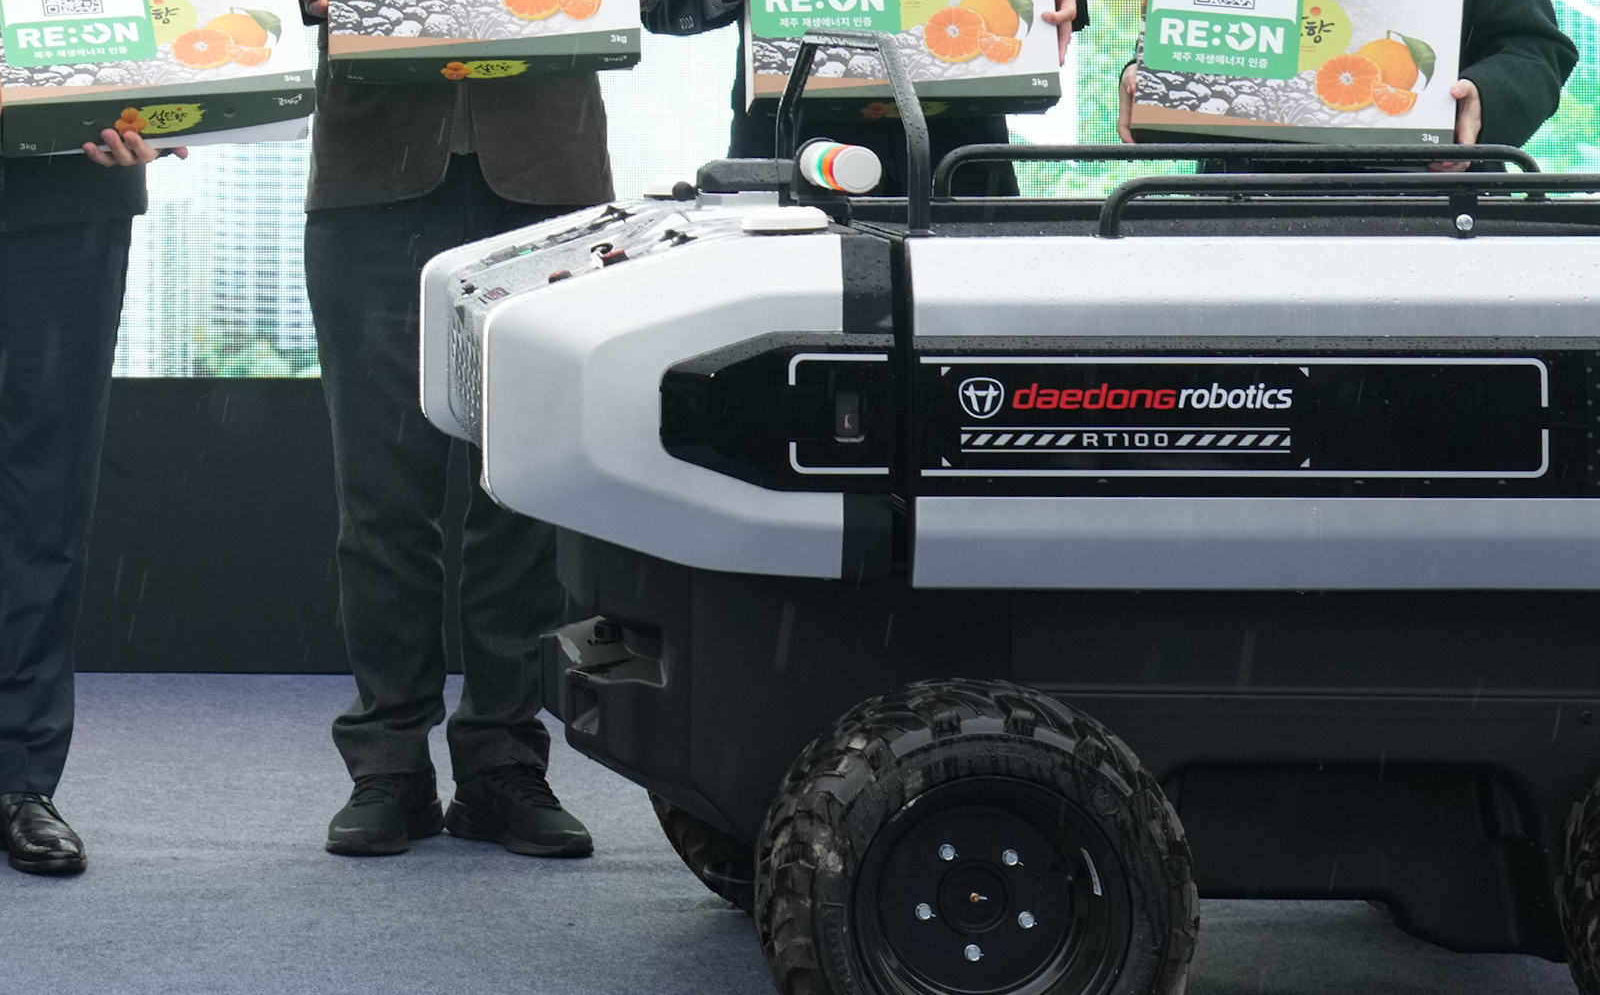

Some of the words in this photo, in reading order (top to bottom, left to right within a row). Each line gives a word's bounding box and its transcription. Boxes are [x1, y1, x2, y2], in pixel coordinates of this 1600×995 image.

[779, 17, 800, 28] 제주
[802, 16, 850, 29] 재생에너지
[852, 16, 873, 28] 인증
[17, 21, 140, 48] RE:ON
[609, 34, 628, 45] 3kg
[1160, 16, 1285, 54] RE:ON
[34, 50, 54, 59] 제주
[56, 47, 106, 58] 재생에너지
[107, 45, 128, 55] 인증
[1172, 51, 1192, 62] 제주
[1195, 53, 1245, 67] 재생에너지
[1248, 57, 1269, 69] 인증
[283, 74, 301, 83] 3kg
[1031, 78, 1049, 88] 3kg
[1421, 133, 1440, 144] 3kg
[18, 142, 37, 152] 3kg
[1082, 432, 1170, 447] RT100
